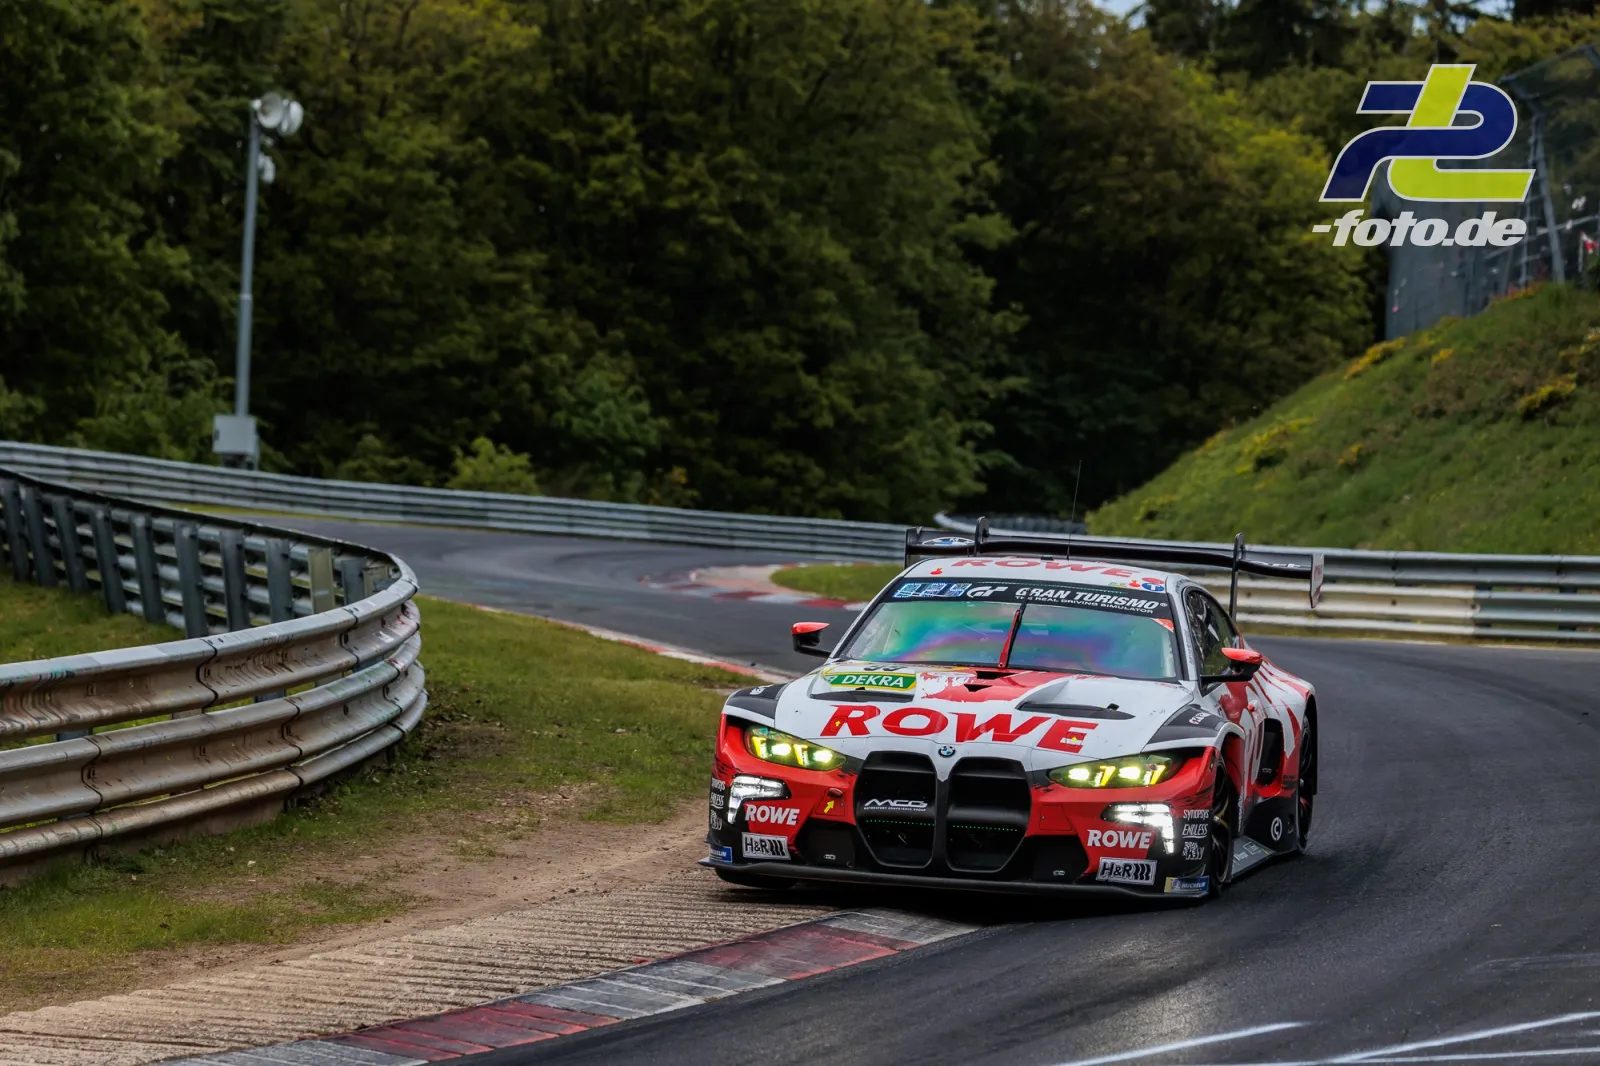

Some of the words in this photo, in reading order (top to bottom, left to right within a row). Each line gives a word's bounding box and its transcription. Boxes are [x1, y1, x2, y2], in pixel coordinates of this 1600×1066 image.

[951, 559, 1141, 578] ROWE
[1015, 587, 1067, 599] GRAN
[1075, 591, 1160, 610] TURISMO
[1061, 599, 1099, 607] DRIVING
[1101, 604, 1154, 614] SIMULATOR
[841, 674, 904, 688] DEKRA
[820, 705, 1098, 753] ROWE
[745, 803, 800, 826] ROWE
[1087, 829, 1152, 849] ROWE
[1182, 824, 1208, 836] ENDLESS
